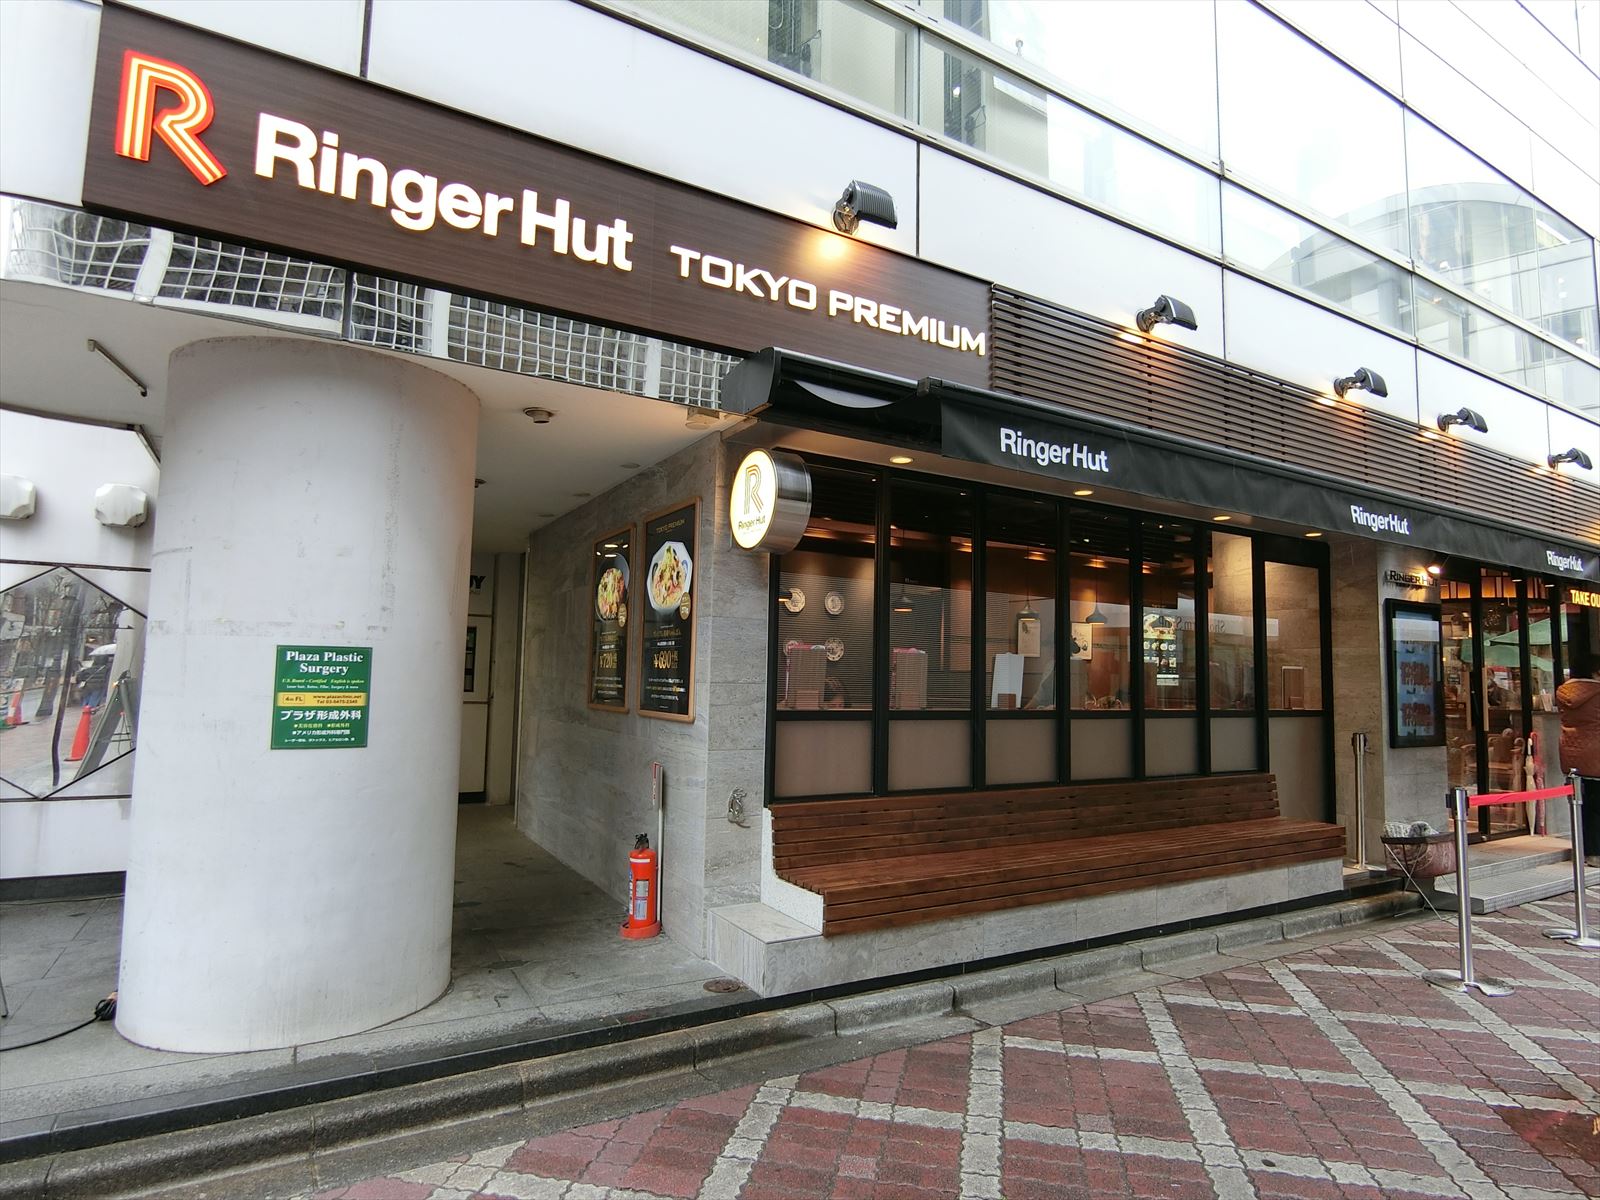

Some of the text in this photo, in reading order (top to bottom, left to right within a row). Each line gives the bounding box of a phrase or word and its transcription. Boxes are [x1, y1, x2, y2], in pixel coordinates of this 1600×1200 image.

[115, 50, 228, 186] R
[255, 112, 634, 272] Ringer Hut
[670, 245, 986, 356] TOKYO PREMIUM
[1000, 427, 1109, 472] Ringer Hut
[1350, 505, 1410, 535] Ringer Hut
[1546, 550, 1584, 572] Ringer Hut
[1390, 570, 1420, 584] RINGER
[1570, 589, 1590, 606] TAKE
[286, 650, 364, 662] Plaza Plastic
[299, 662, 349, 675] Surgery
[281, 710, 361, 720] プラザ形成外科
